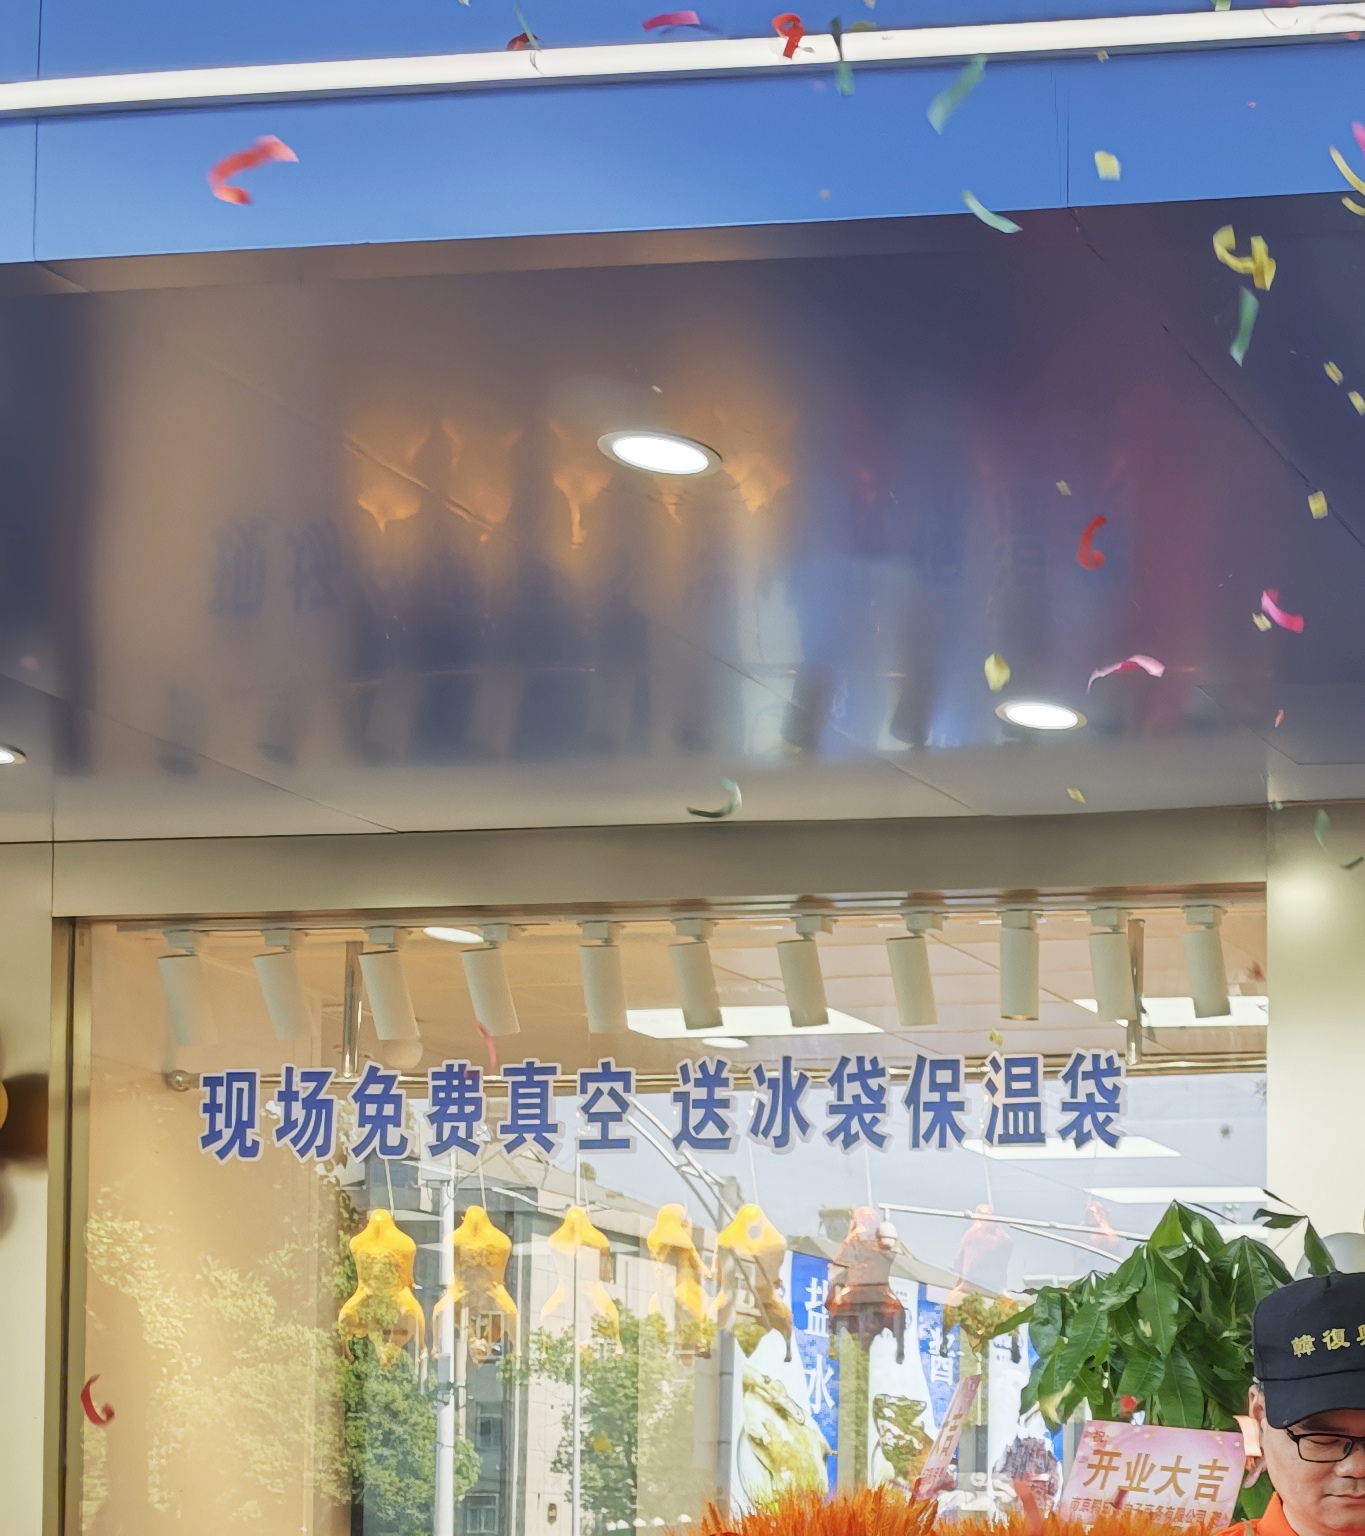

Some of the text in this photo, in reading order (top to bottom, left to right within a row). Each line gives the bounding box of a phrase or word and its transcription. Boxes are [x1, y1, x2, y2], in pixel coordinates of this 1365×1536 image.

[199, 1053, 1124, 1160] 现场免费真空 送冰袋保温袋
[1083, 1449, 1230, 1502] 开业大吉
